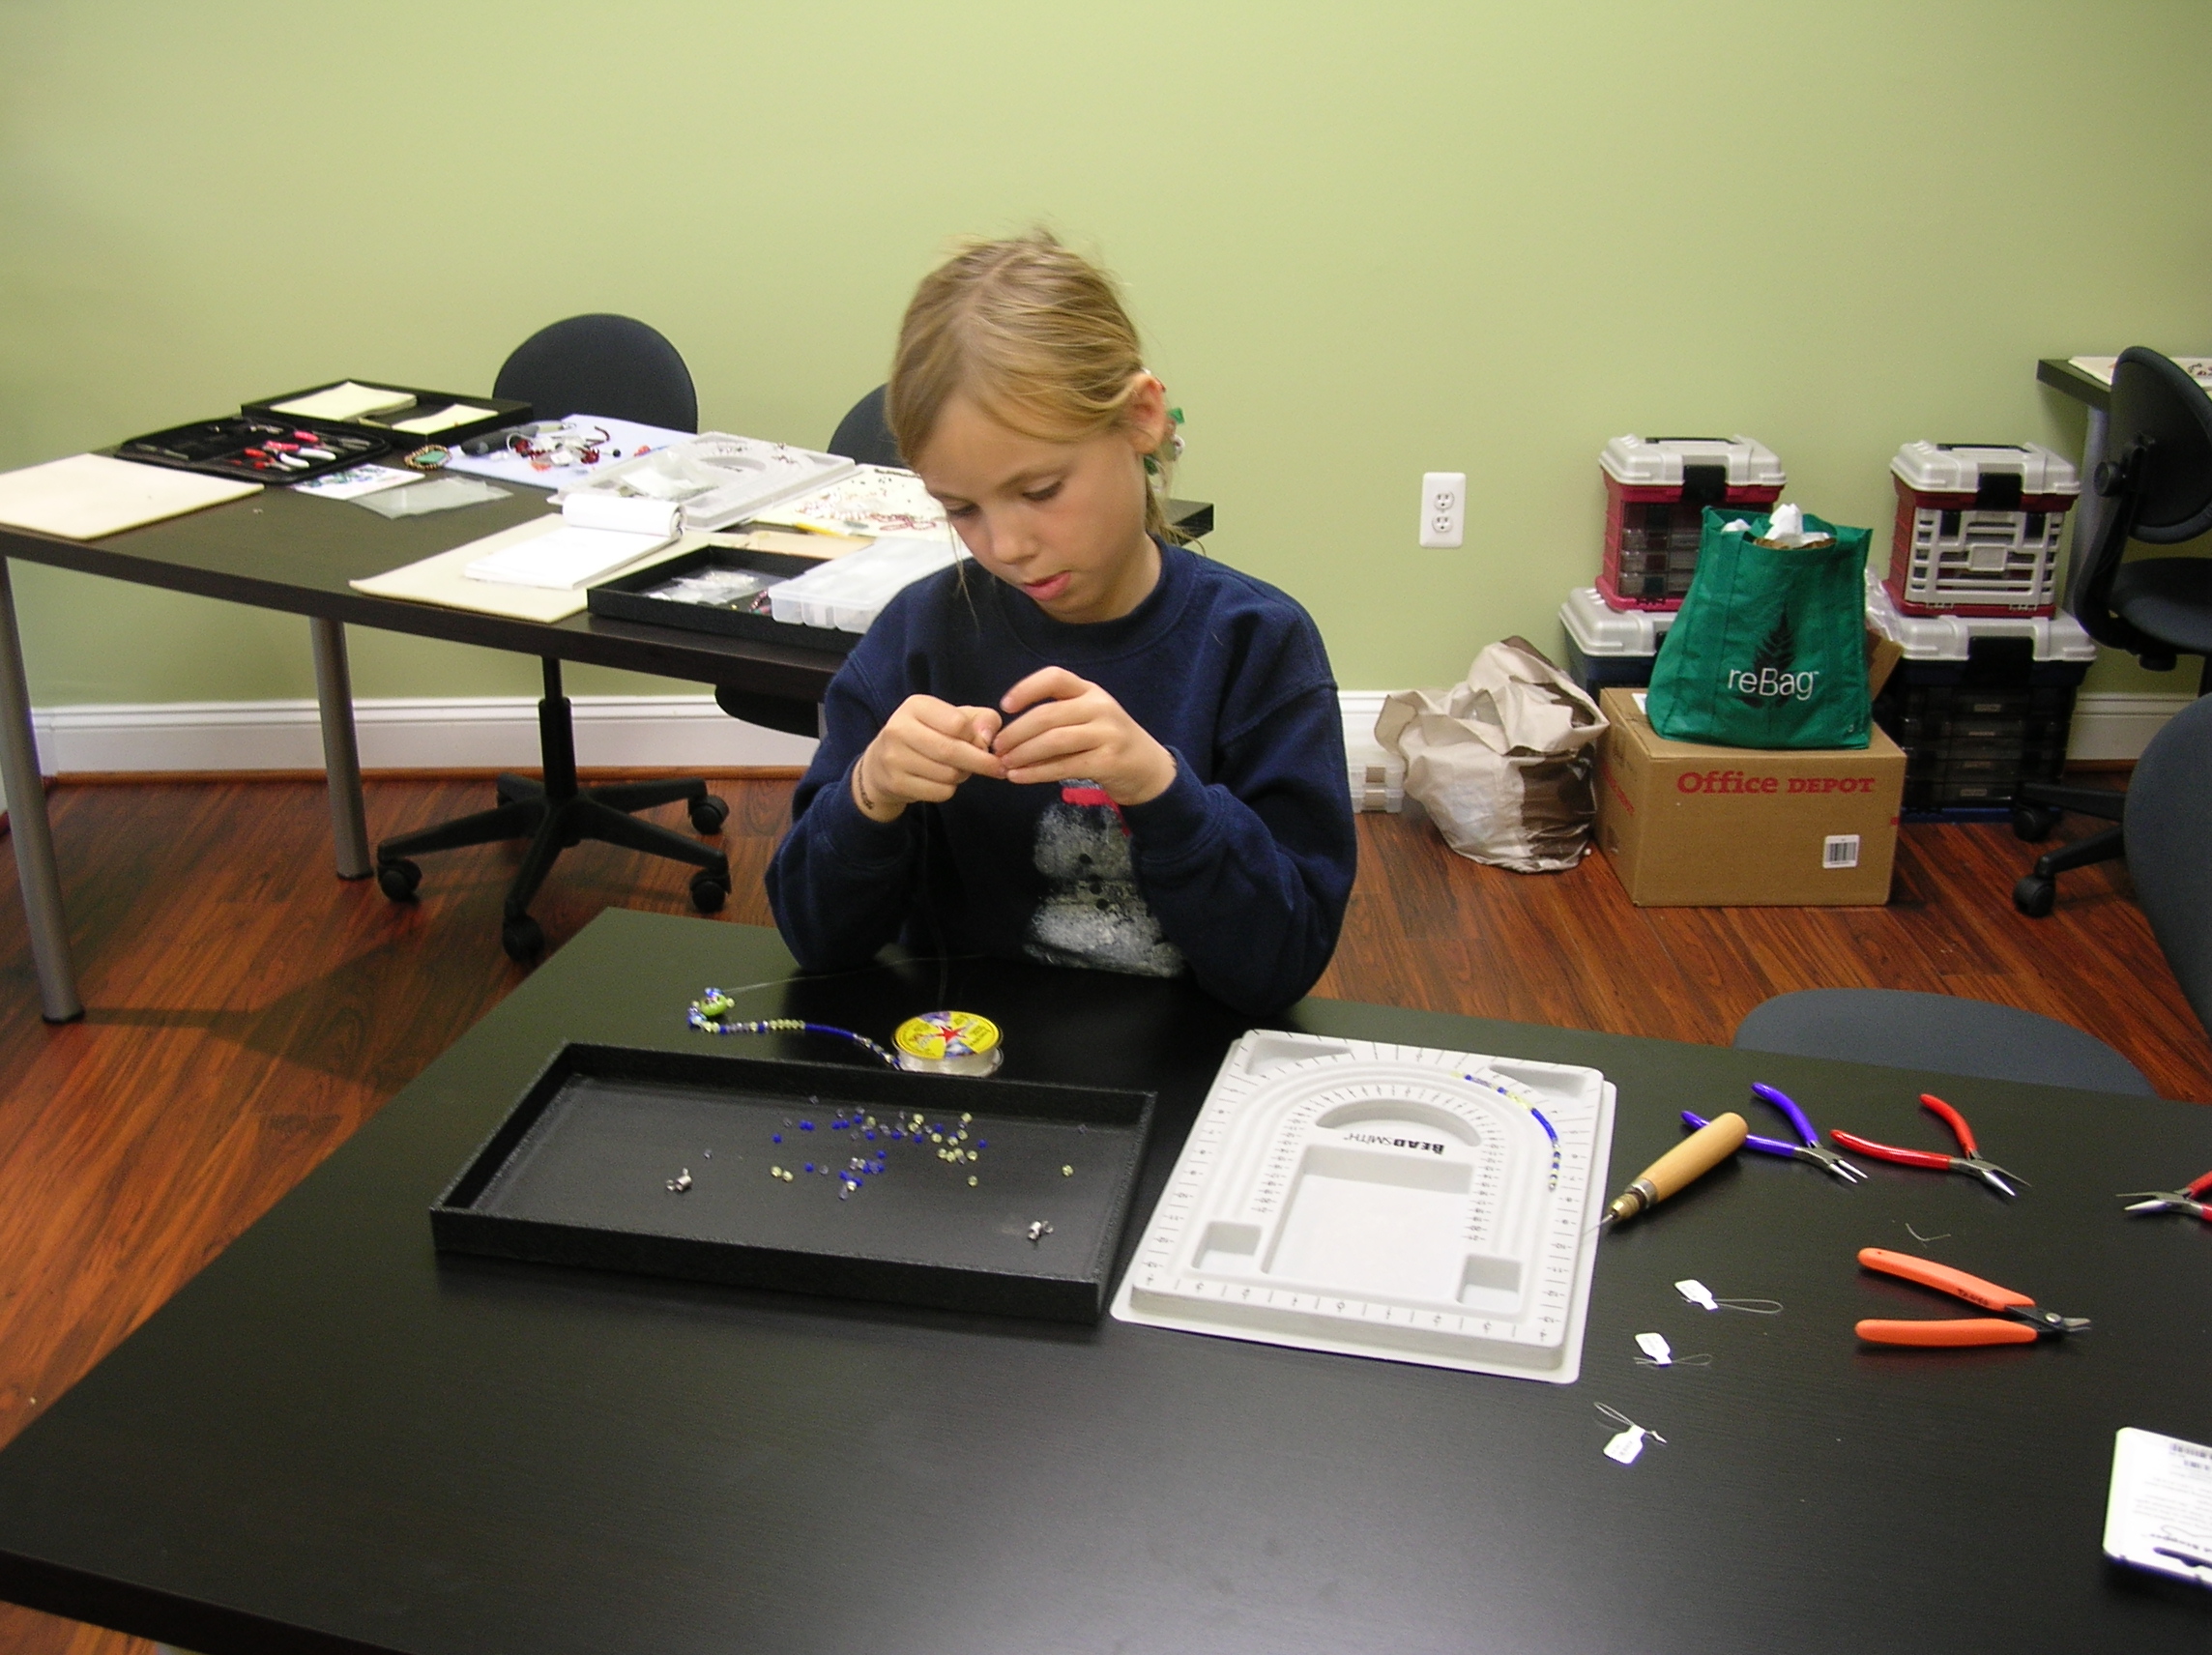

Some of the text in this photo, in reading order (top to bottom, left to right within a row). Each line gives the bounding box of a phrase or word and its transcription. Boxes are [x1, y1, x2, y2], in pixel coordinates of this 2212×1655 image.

[1727, 667, 1816, 702] reBag
[1675, 769, 1877, 795] Office DEPOT
[1348, 1132, 1445, 1155] BEADSMITH
